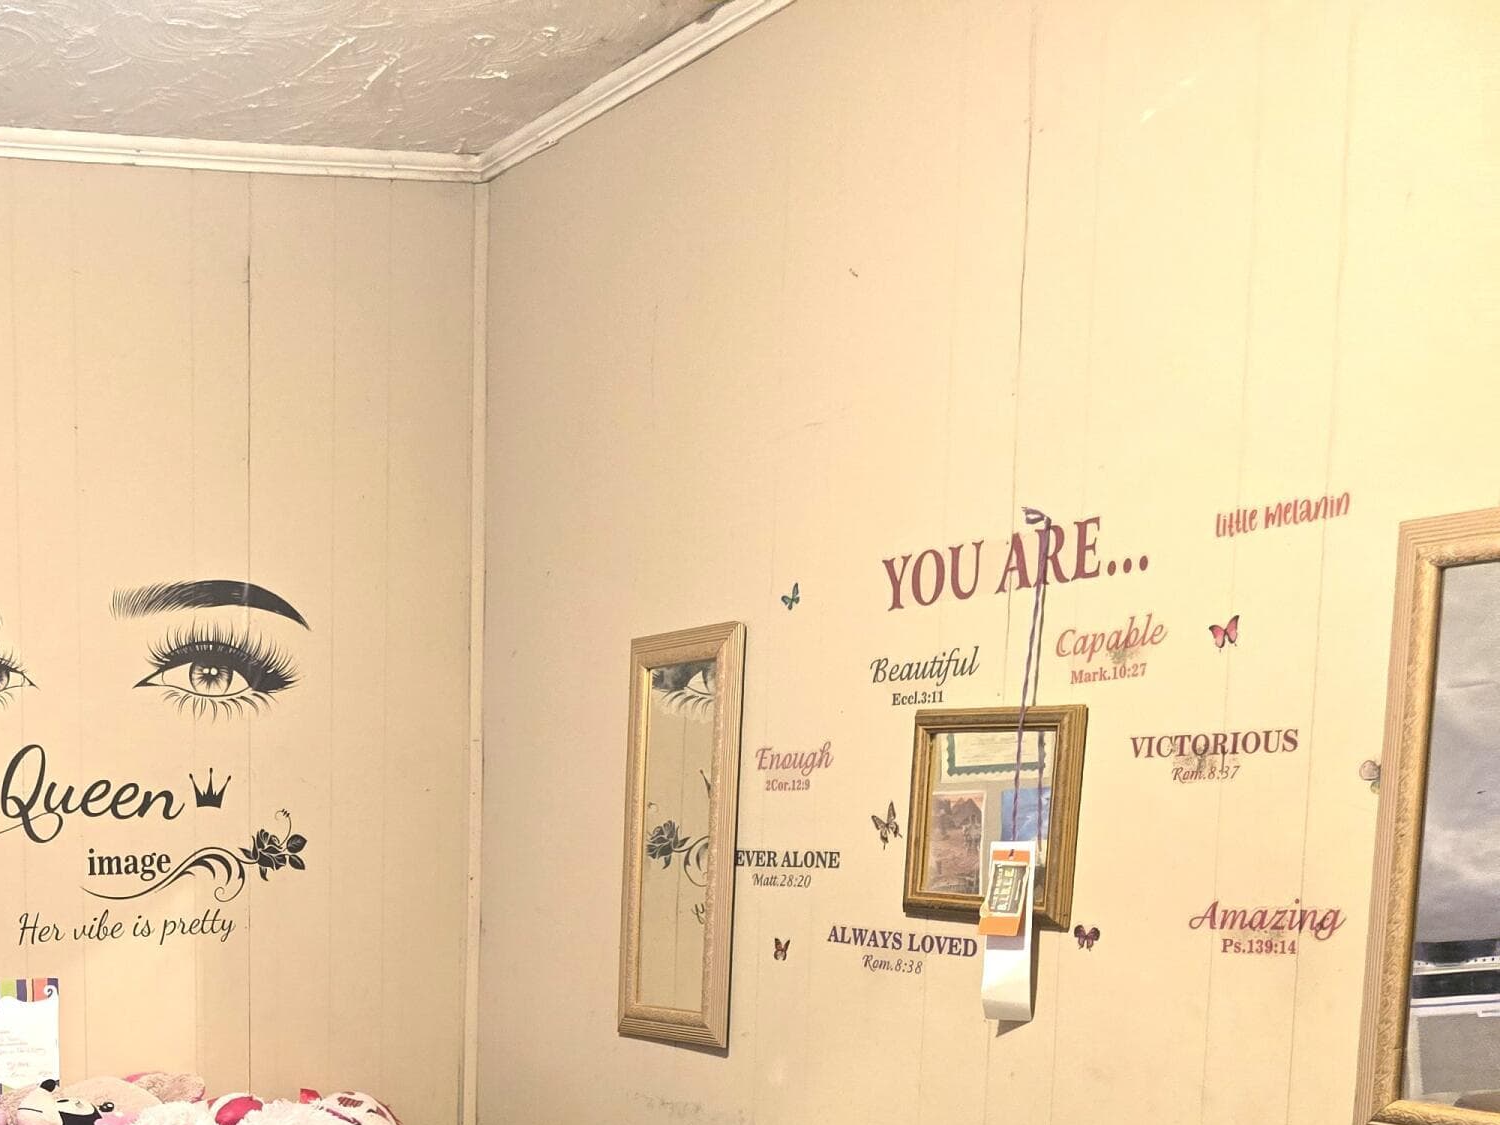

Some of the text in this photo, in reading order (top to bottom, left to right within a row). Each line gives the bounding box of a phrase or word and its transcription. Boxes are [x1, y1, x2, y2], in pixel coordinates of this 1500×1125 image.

[1215, 492, 1351, 538] little melanin
[882, 540, 984, 611] YOU
[1056, 612, 1168, 663] Capable
[870, 646, 980, 687] Beautiful
[1069, 663, 1148, 685] Mark.10:27
[891, 690, 944, 706] Eccl.3:11
[755, 741, 834, 777] Enough
[1131, 728, 1299, 759] VICTORIOUS
[88, 848, 171, 880] image
[734, 849, 841, 869] EVER ALONE
[18, 908, 237, 945] Her vibe is pretty
[1188, 898, 1347, 941] Amazing
[827, 925, 978, 958] ALWAYS LOVED
[1221, 938, 1296, 955] Ps.139:14
